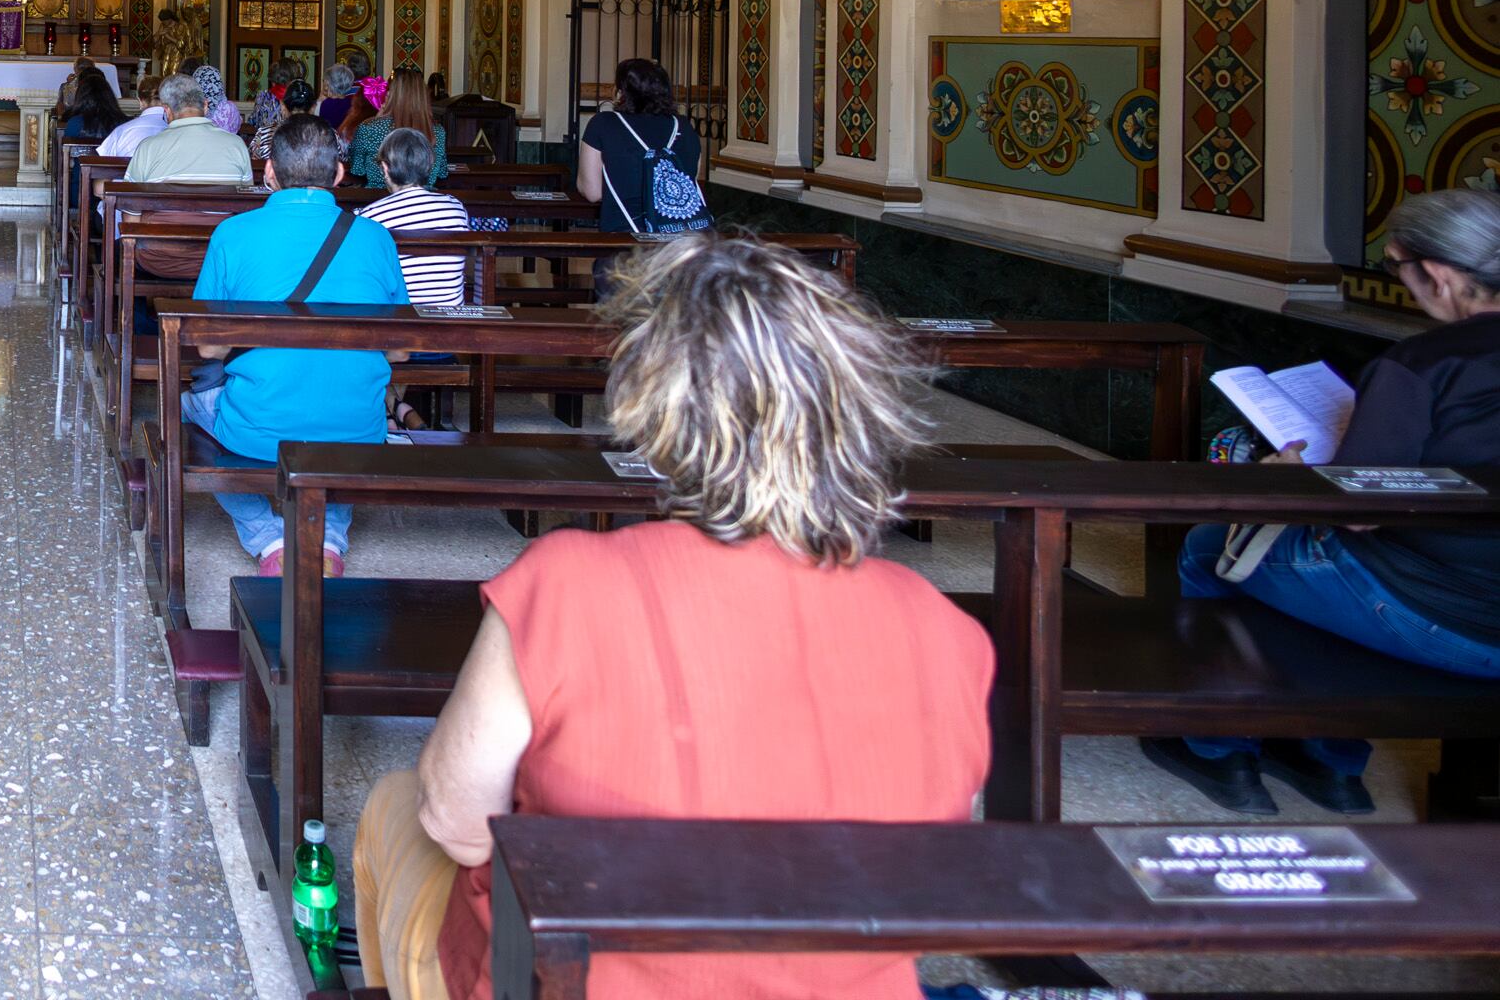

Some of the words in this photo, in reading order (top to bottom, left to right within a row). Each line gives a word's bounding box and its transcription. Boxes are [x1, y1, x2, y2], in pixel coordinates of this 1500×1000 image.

[1166, 836, 1223, 854] POR
[1218, 836, 1306, 854] FAVOR
[1214, 871, 1324, 890] GRACIAS
